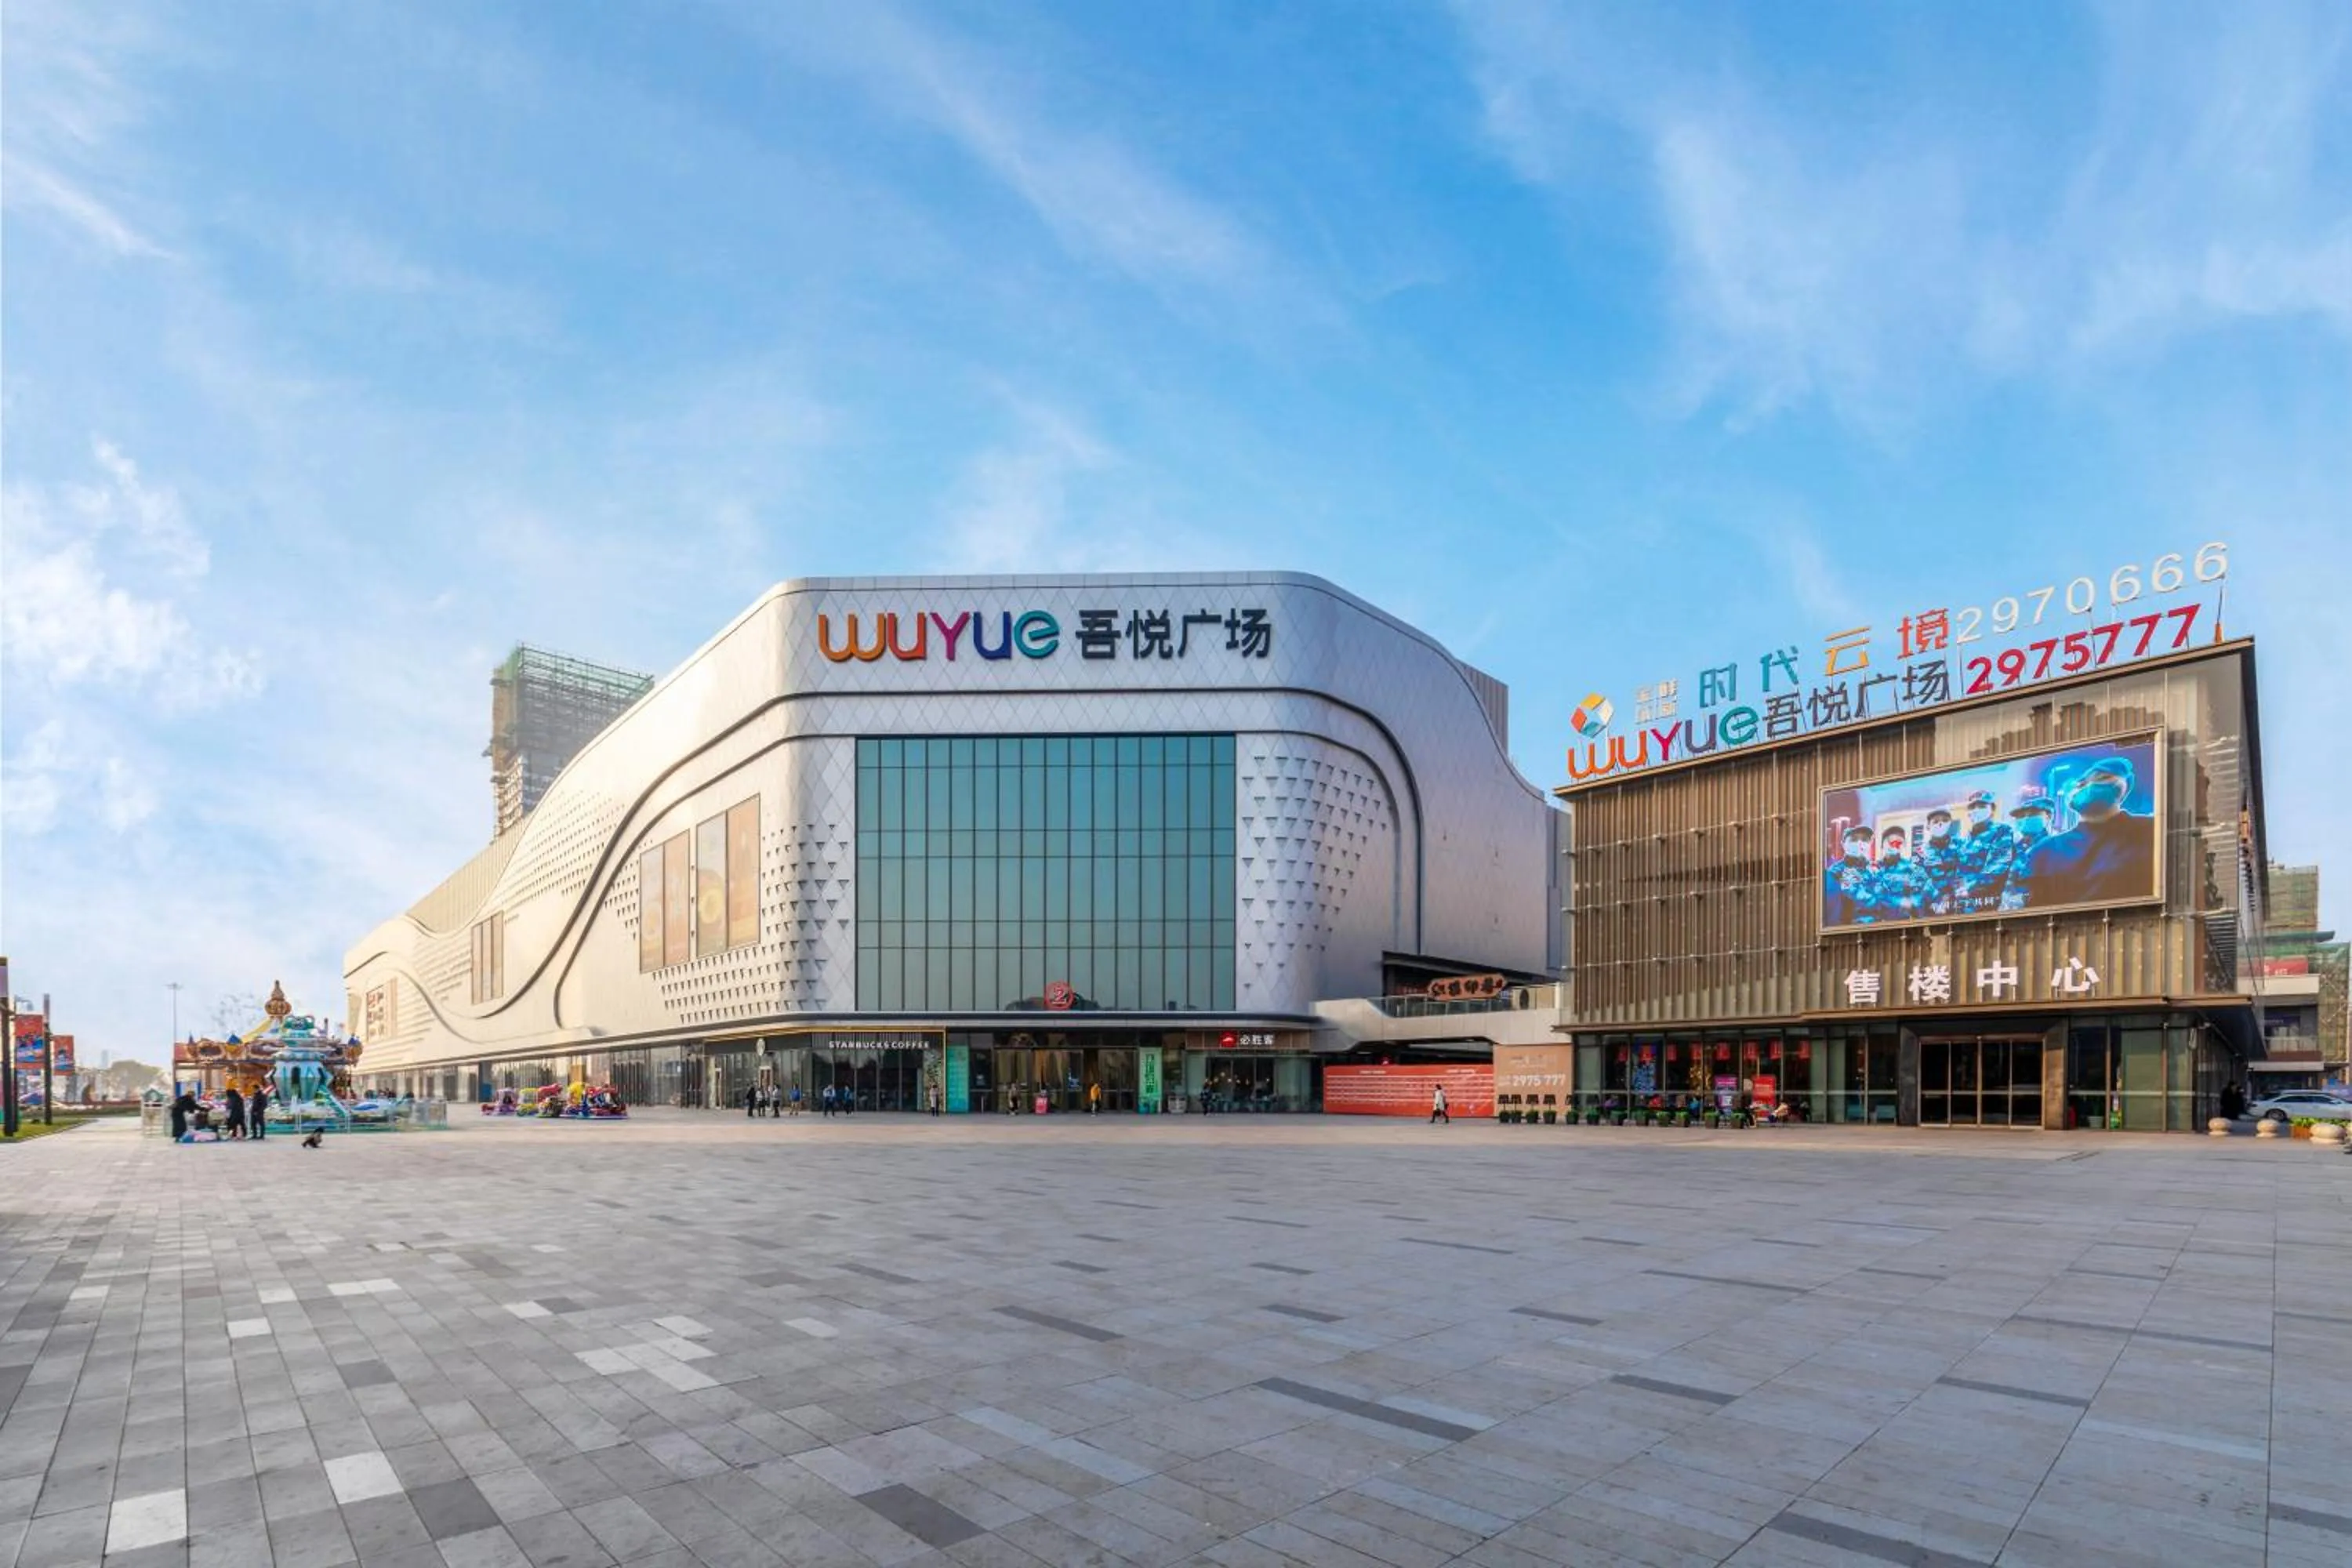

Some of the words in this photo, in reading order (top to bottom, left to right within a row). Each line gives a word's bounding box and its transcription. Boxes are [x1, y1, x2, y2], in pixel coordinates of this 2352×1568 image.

[1075, 608, 1272, 660] 吾悦广场
[1699, 608, 1950, 709] 时代云境
[1956, 541, 2228, 644] 2970666
[1762, 659, 1951, 738] 吾悦广场
[1965, 603, 2201, 695] 2975777
[1844, 956, 2100, 1004] 售楼中心
[829, 1040, 890, 1049] STARBUCKS
[891, 1040, 930, 1049] COFFEE
[1512, 1074, 1542, 1087] 2975
[1544, 1073, 1566, 1086] 777
